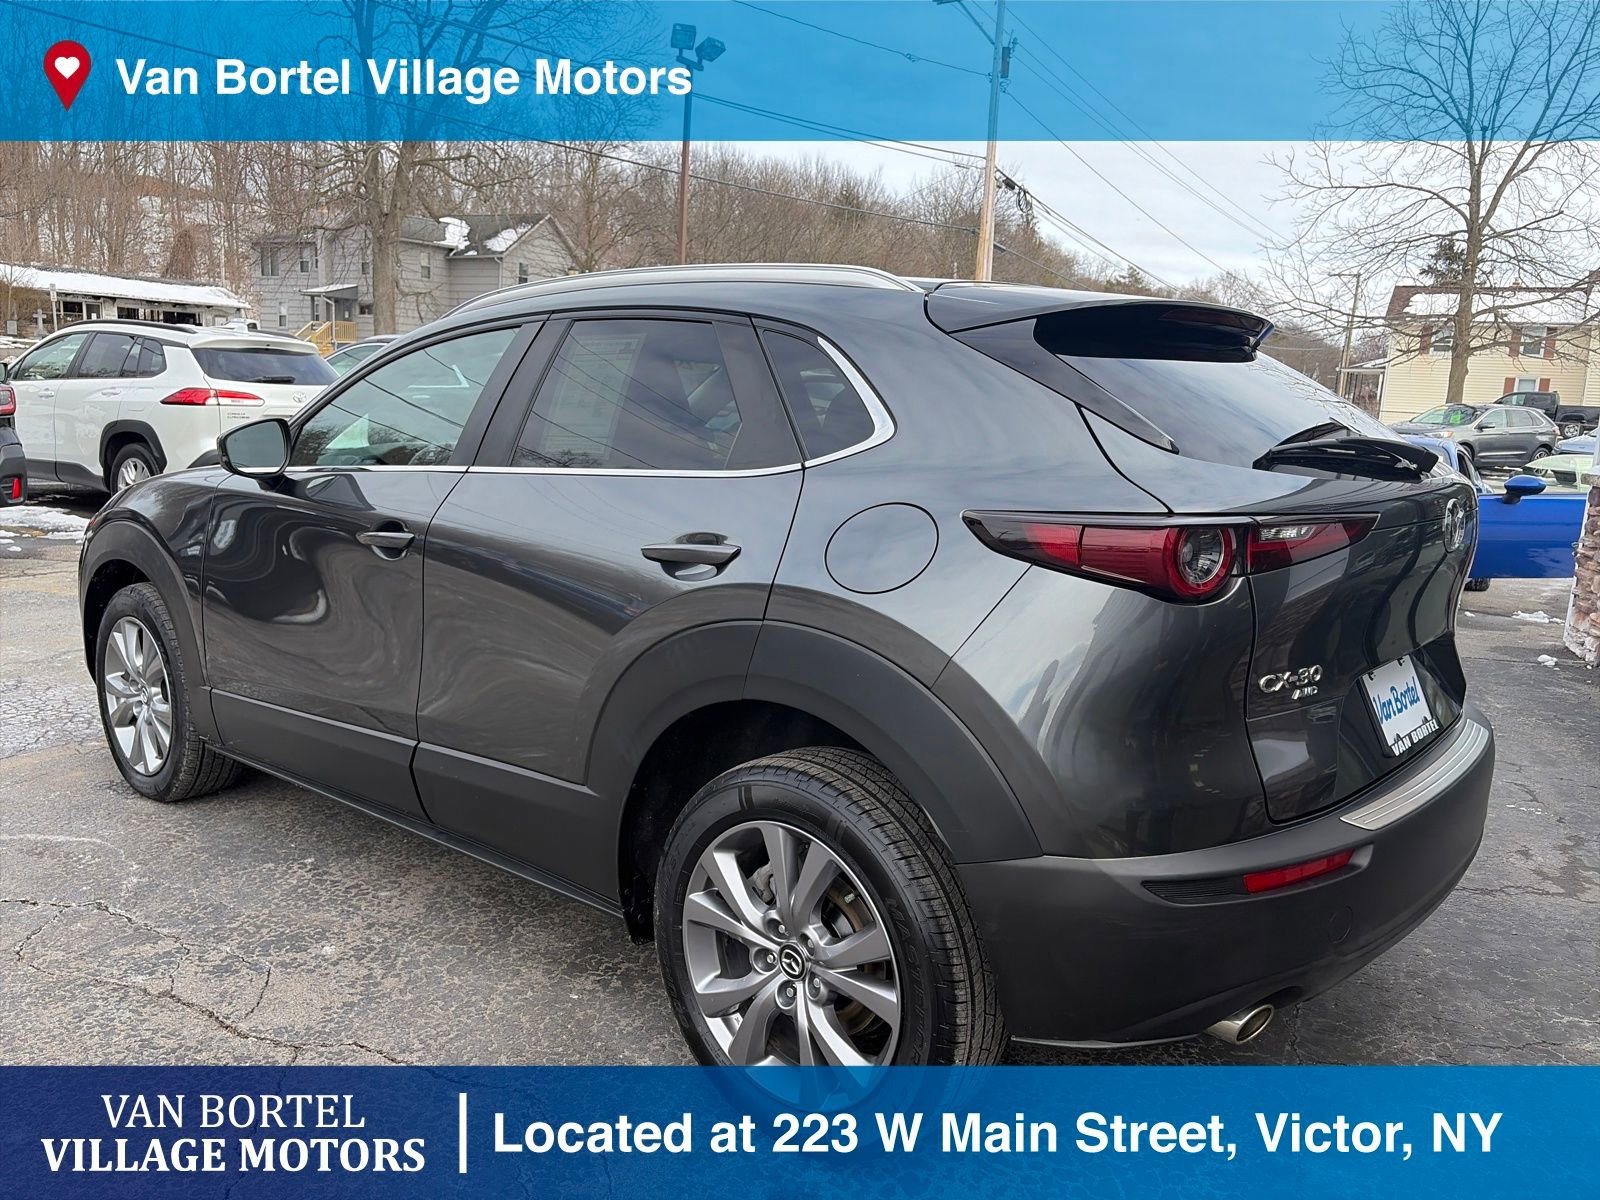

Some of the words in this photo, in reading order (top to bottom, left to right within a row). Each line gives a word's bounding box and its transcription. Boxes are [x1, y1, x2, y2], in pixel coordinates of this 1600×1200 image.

[1258, 665, 1323, 693] CX-30
[1372, 694, 1396, 725] Van
[1390, 676, 1420, 714] Bortel
[1391, 735, 1412, 756] VAN
[1410, 719, 1440, 744] BORTEL
